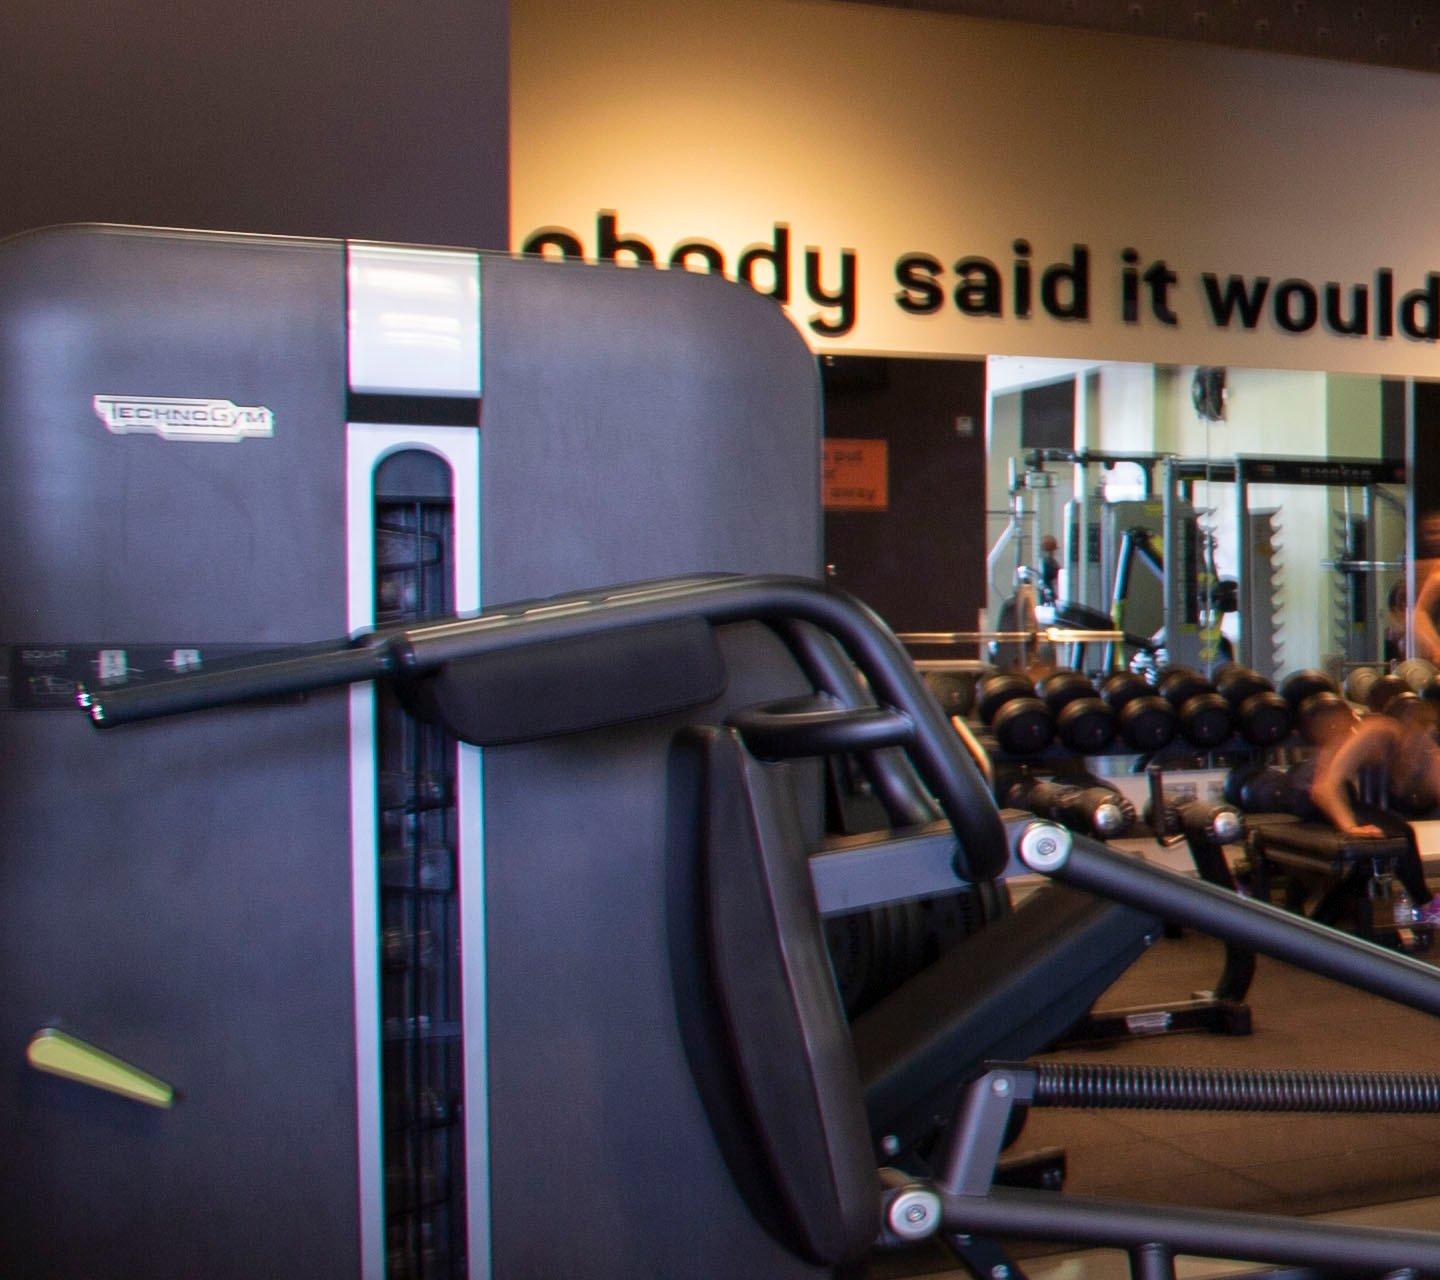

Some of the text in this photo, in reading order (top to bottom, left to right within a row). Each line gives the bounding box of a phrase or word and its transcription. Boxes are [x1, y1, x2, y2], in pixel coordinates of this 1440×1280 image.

[894, 237, 1090, 321] said
[1121, 247, 1179, 326] it
[99, 398, 271, 433] TECHNOGYM
